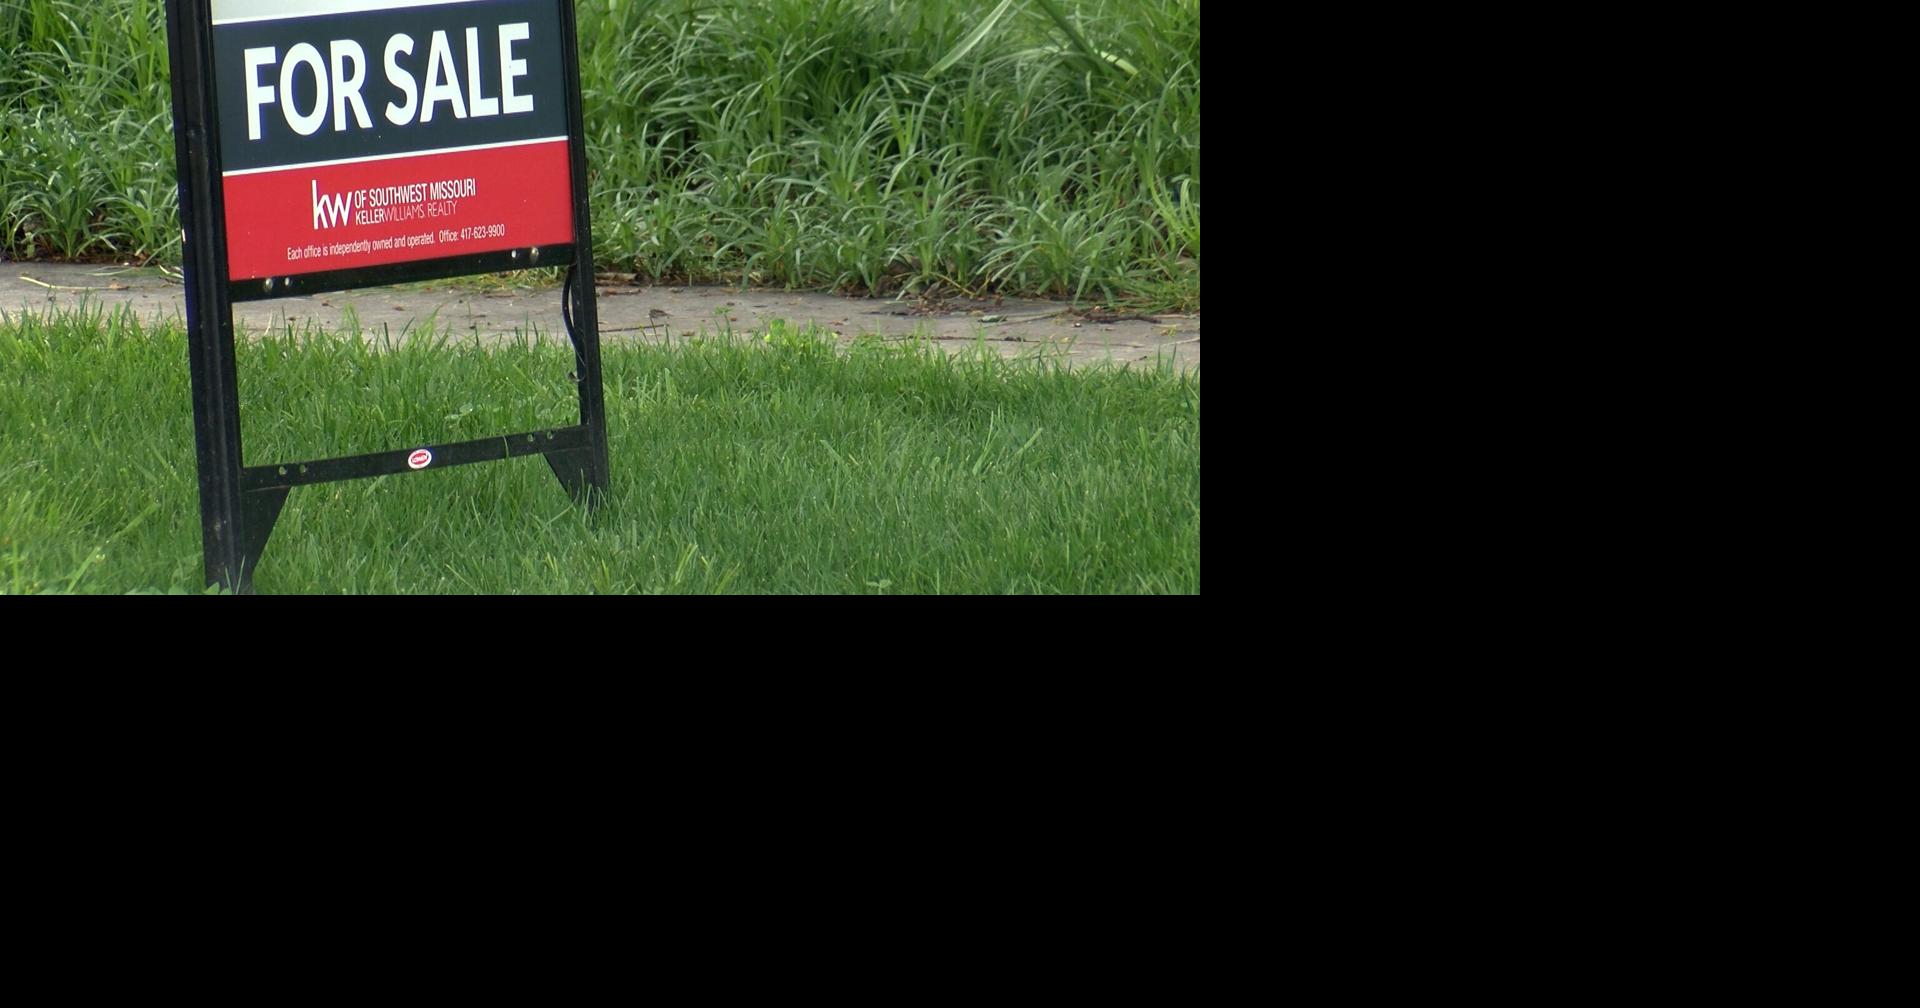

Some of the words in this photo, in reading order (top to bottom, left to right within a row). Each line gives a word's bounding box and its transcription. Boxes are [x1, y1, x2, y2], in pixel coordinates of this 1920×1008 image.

[243, 38, 373, 141] FOR
[383, 22, 535, 126] SALE
[311, 179, 353, 230] kw
[354, 189, 367, 209] OF
[369, 183, 428, 207] SOUTHWEST
[430, 178, 476, 201] MISSOURI
[427, 200, 458, 218] REALTY
[287, 247, 303, 260] Each
[303, 244, 322, 258] office
[322, 243, 329, 257] is
[329, 239, 371, 256] independently
[372, 236, 393, 251] owned
[394, 234, 406, 249] and
[406, 231, 435, 249] operated.
[438, 228, 460, 243] Office:
[460, 223, 505, 240] 417-623-9900
